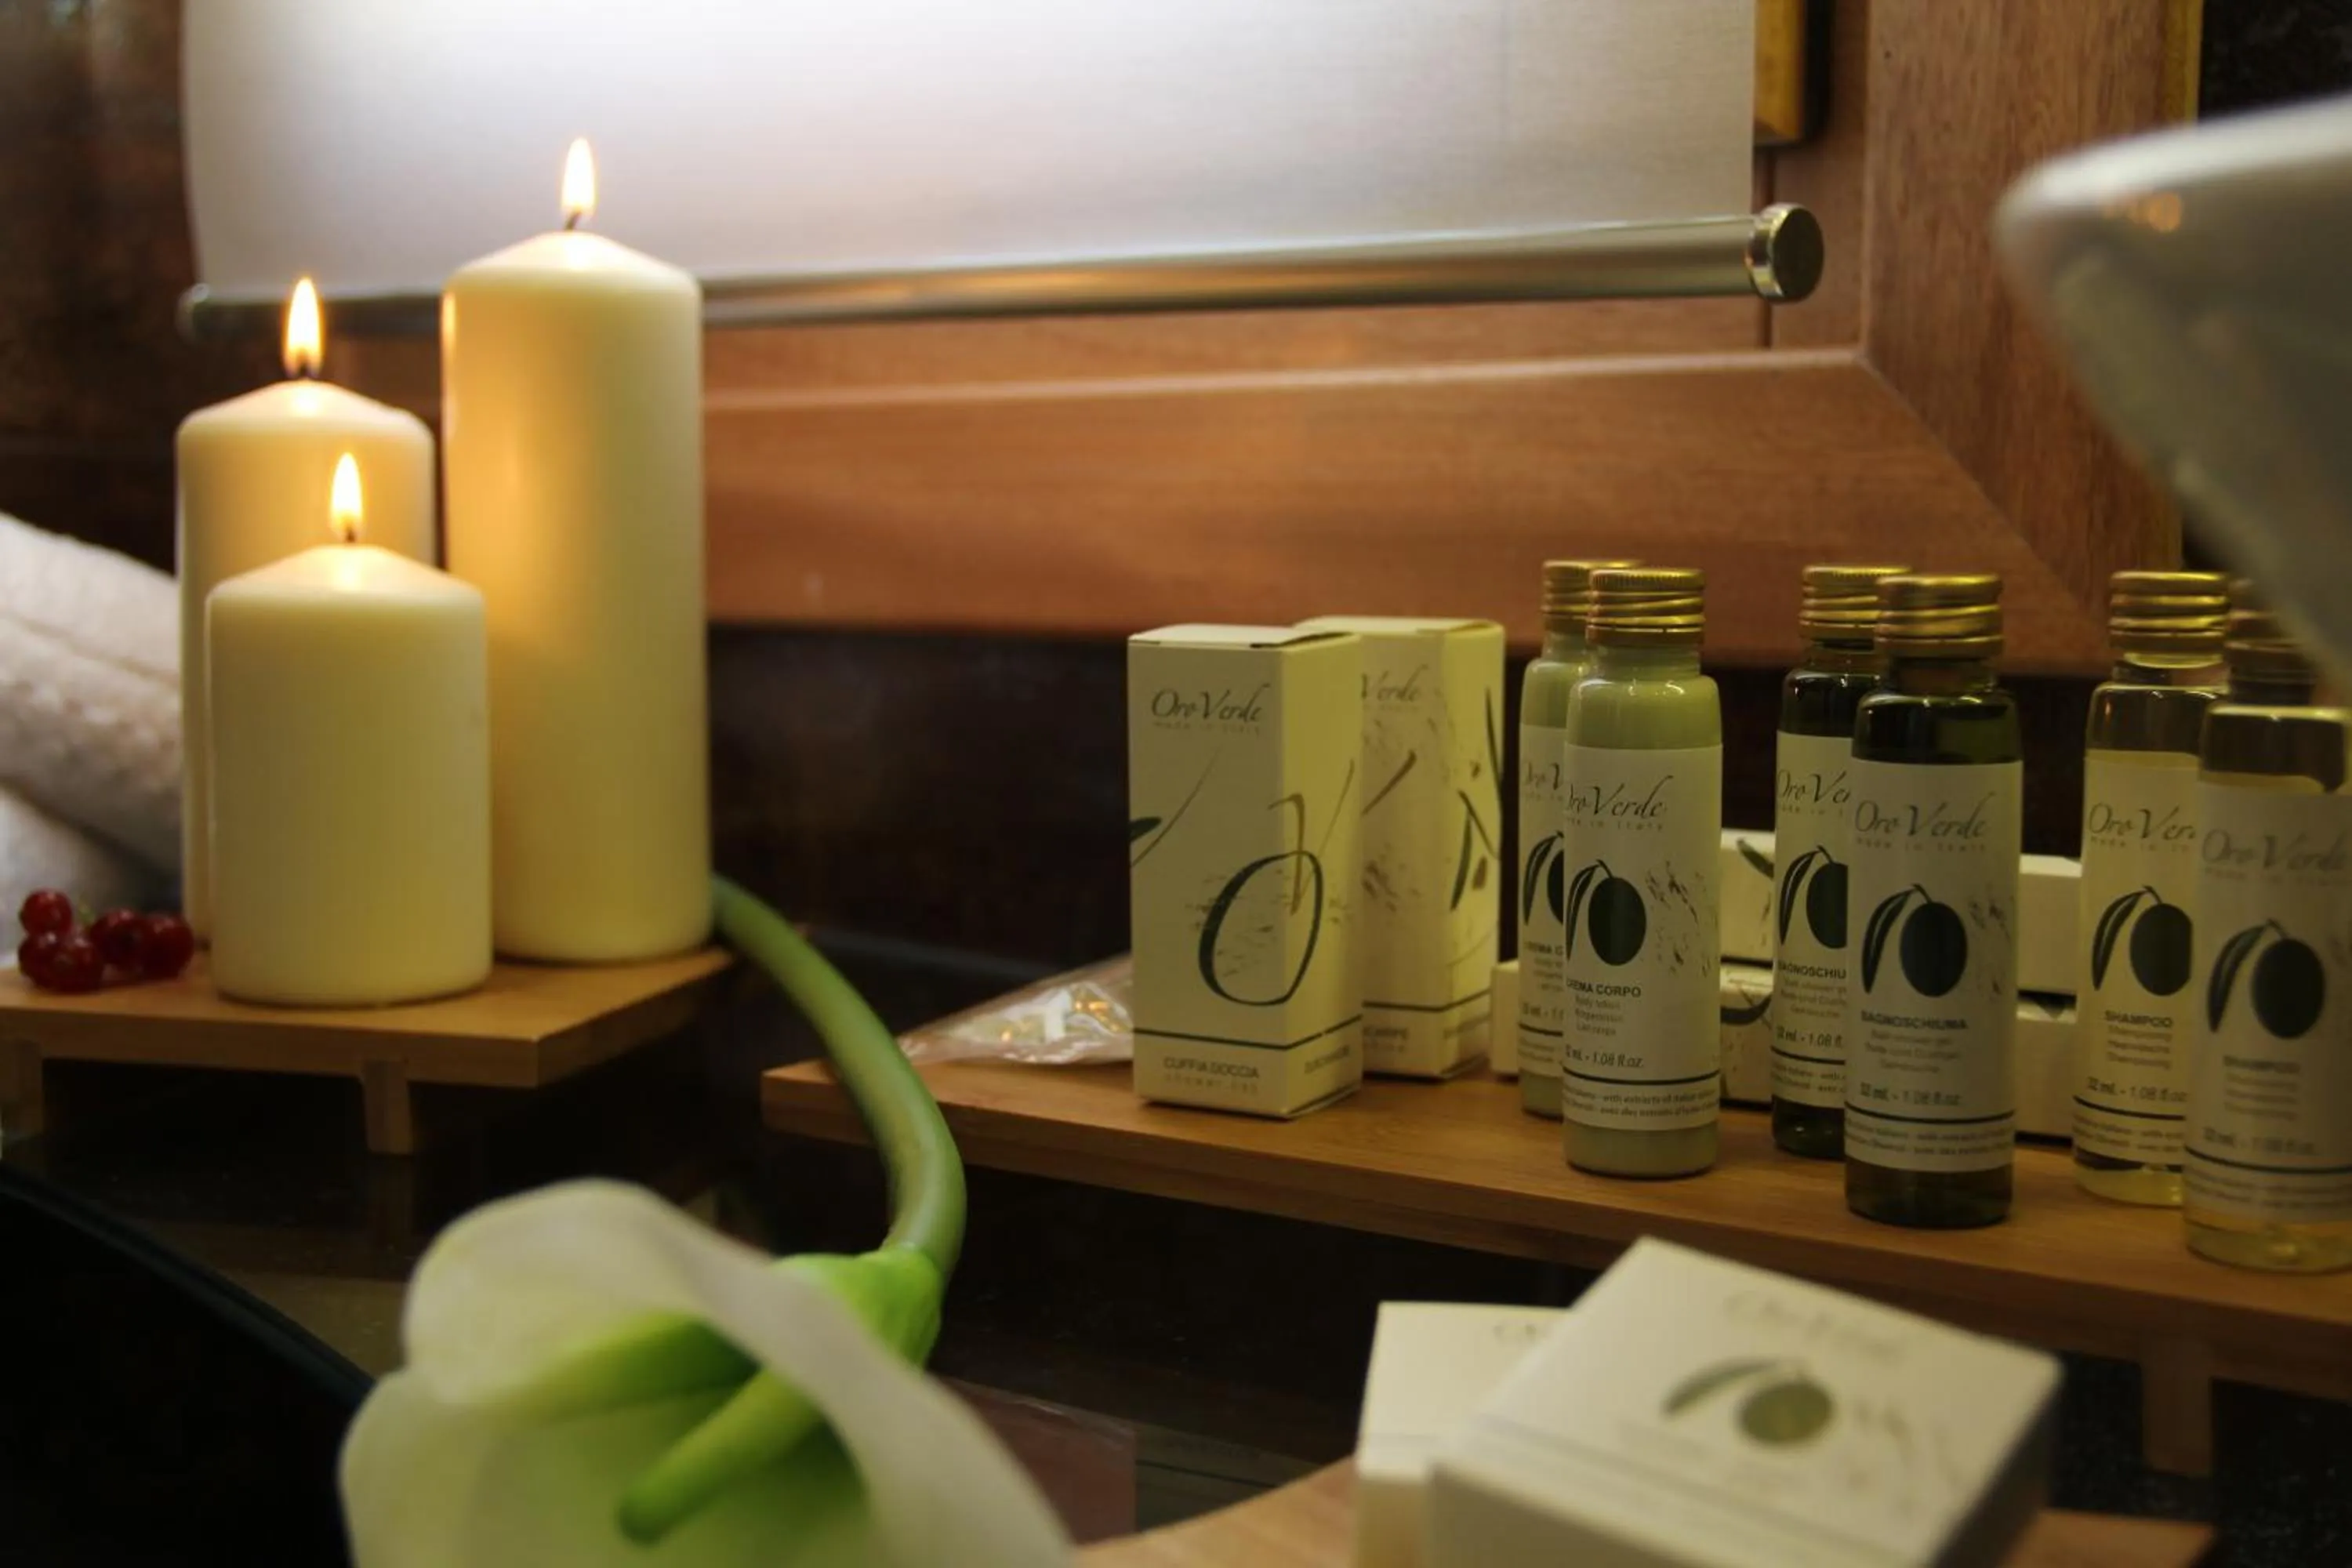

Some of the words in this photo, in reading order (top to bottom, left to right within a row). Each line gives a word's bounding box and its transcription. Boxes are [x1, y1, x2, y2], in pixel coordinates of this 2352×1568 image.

[1151, 688, 1198, 720] Oro
[1198, 682, 1272, 724] Verde
[1584, 774, 1675, 819] Verde
[1855, 800, 1900, 834] Oro
[1903, 790, 1997, 840] Verde
[2089, 802, 2134, 836] Oro
[2138, 804, 2196, 841] Ver
[1777, 960, 1847, 979] BAGNOSCHIU
[1595, 984, 1642, 999] CORPO
[2104, 1009, 2174, 1028] SHAMPOO
